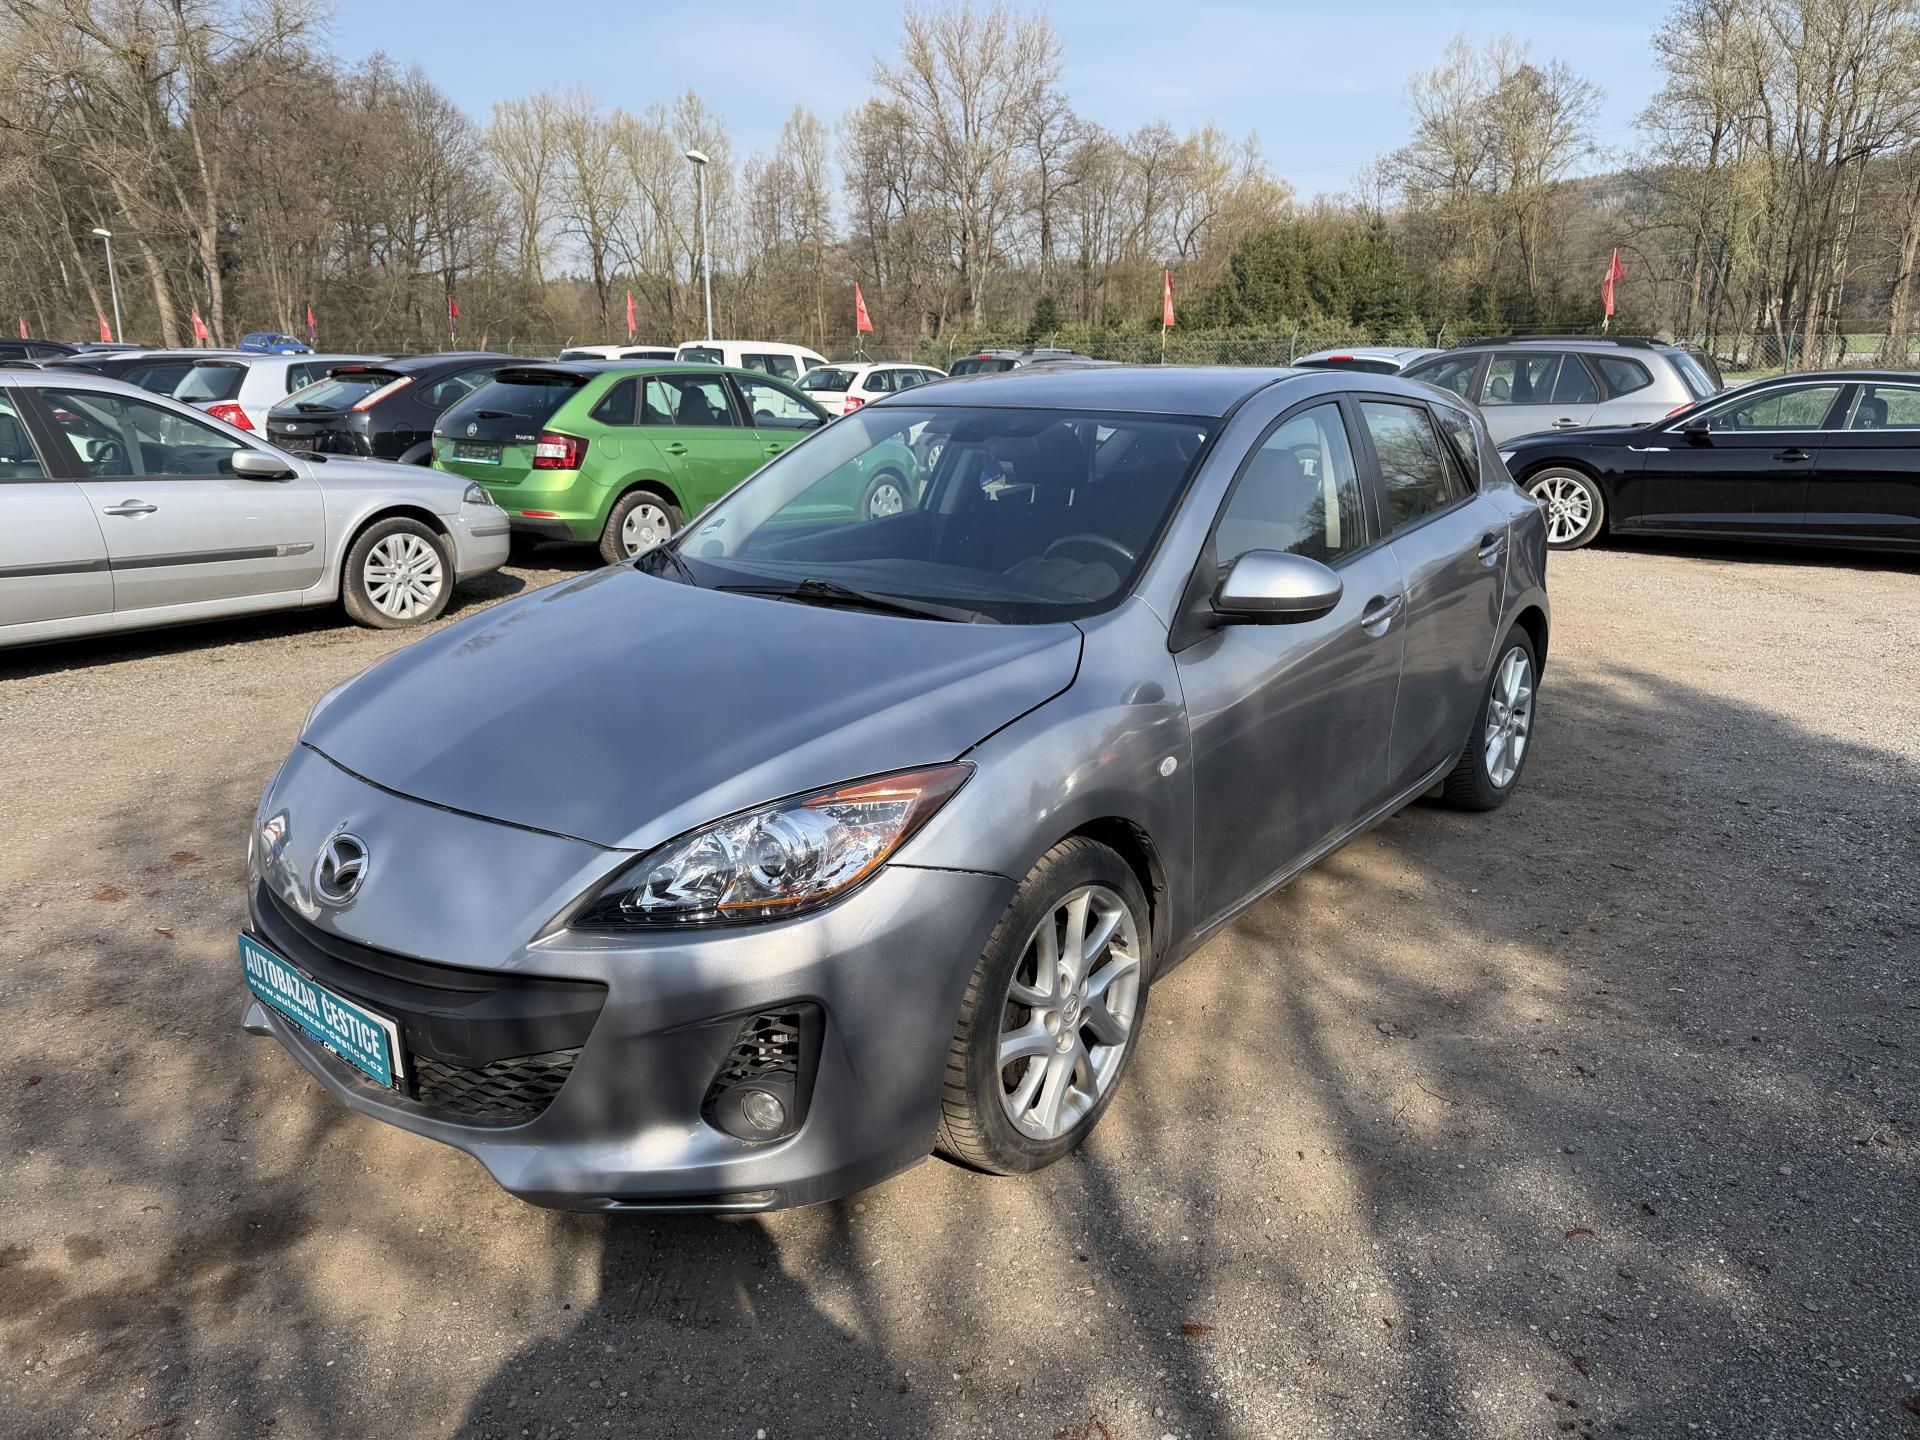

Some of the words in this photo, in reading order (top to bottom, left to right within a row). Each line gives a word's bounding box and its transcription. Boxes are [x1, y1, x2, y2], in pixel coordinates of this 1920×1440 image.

[245, 946, 320, 1017] AUTOBAZAR
[321, 992, 382, 1060] ČESTICE
[249, 976, 383, 1075] www.autobazar-cestice.cz
